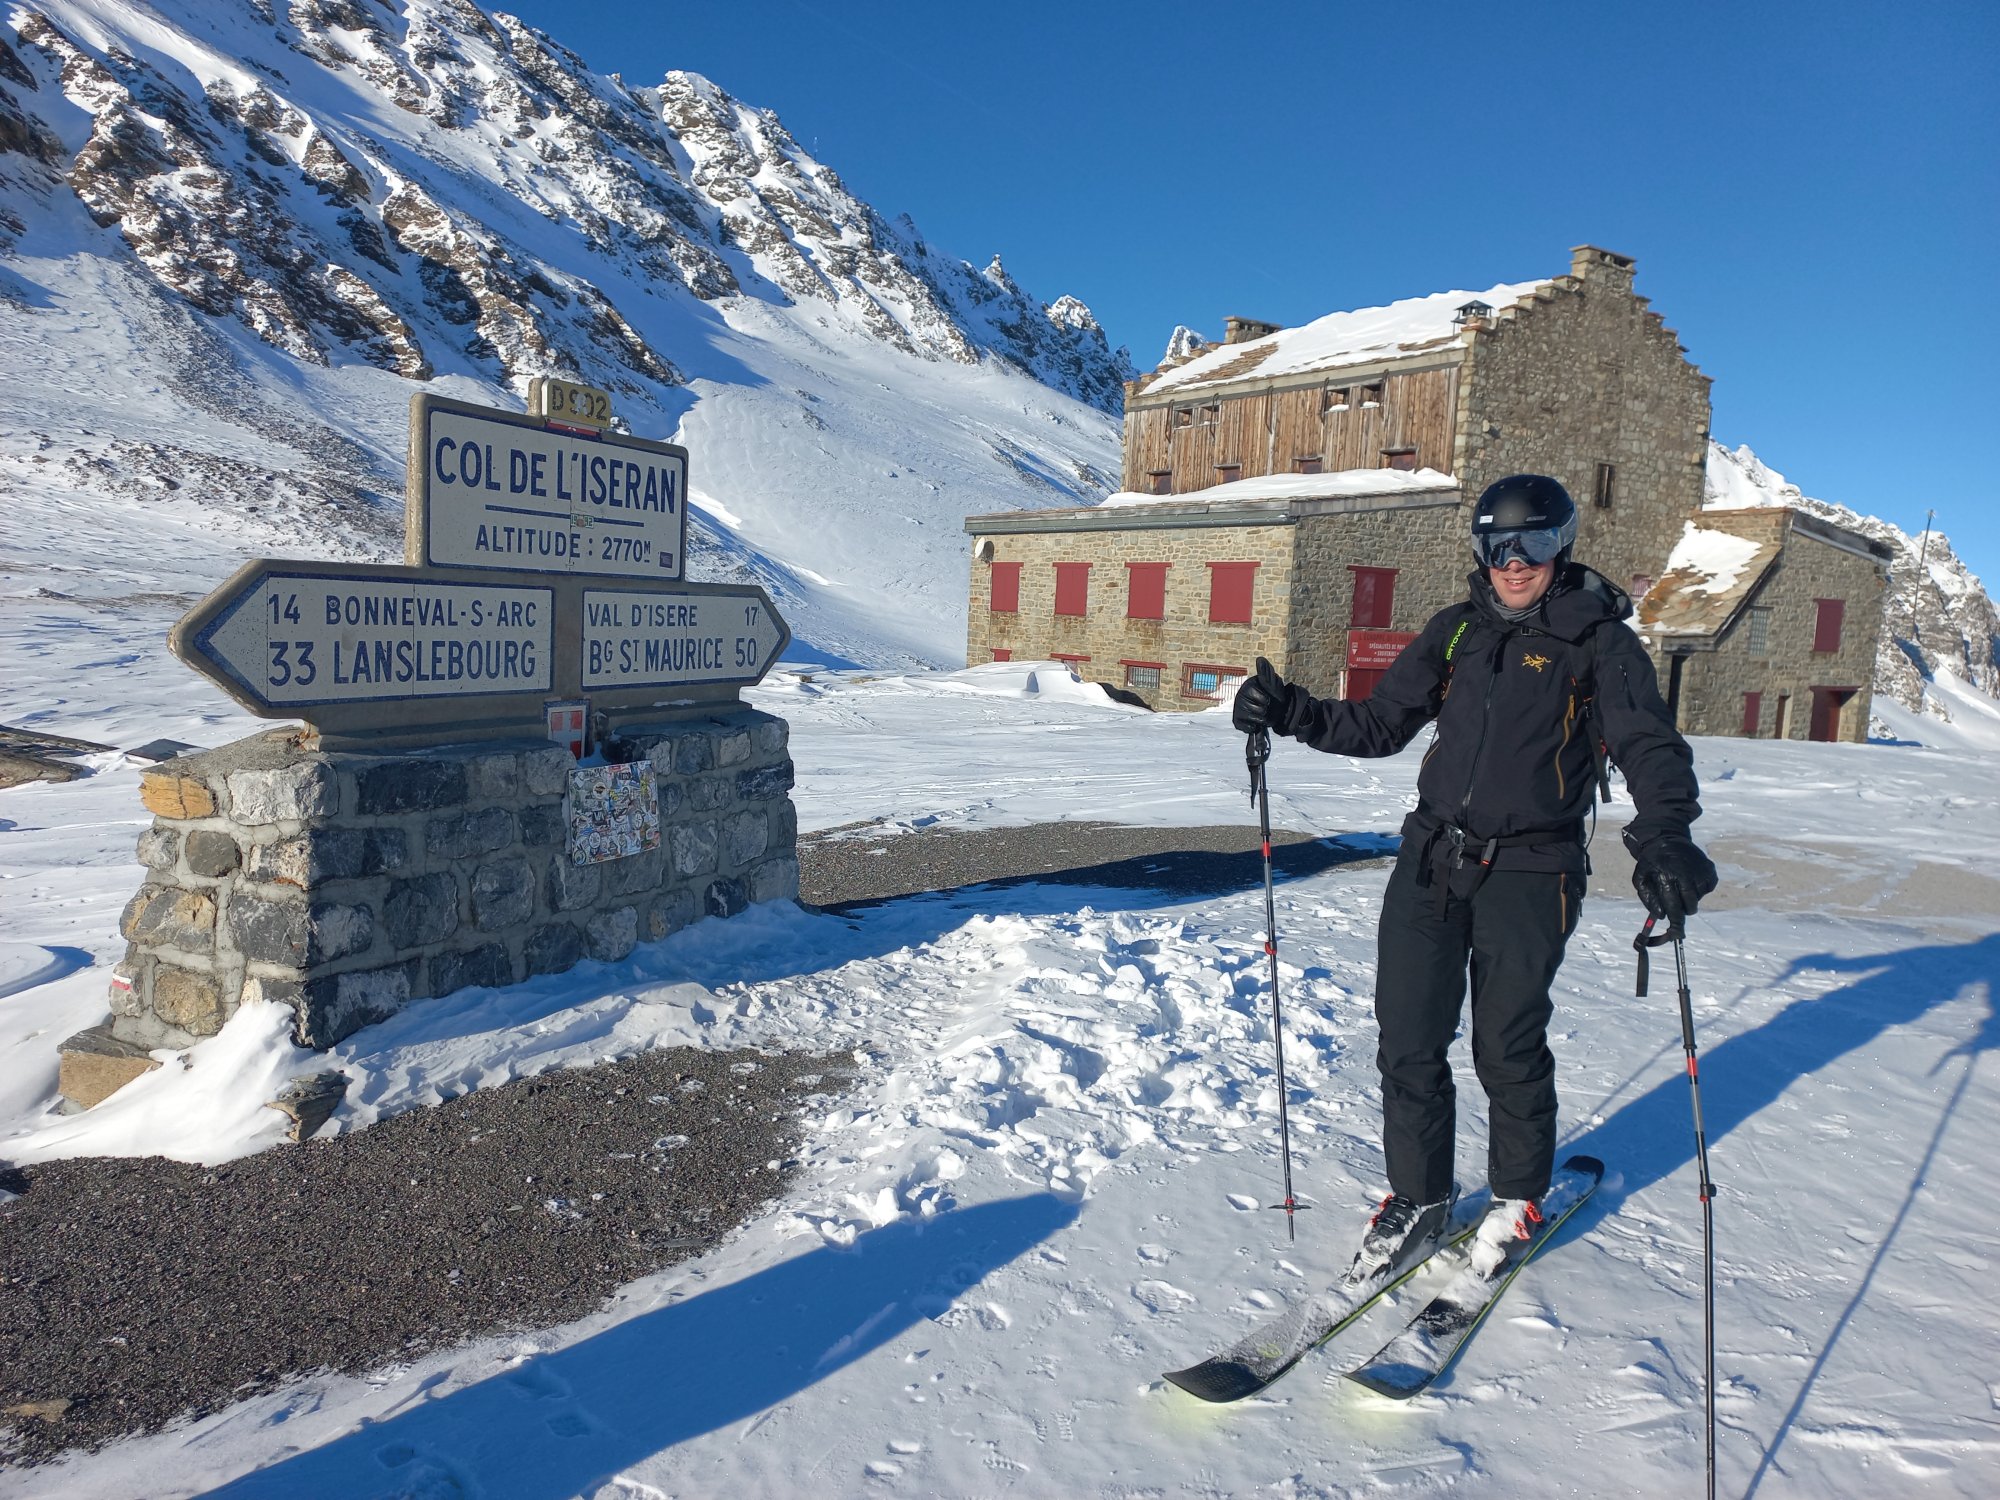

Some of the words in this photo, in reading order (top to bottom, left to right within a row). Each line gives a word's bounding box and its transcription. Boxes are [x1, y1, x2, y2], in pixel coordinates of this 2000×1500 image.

[552, 384, 564, 411] D
[435, 437, 501, 491] COL
[509, 449, 547, 497] DE
[557, 449, 676, 514] L'ISERAN
[475, 524, 581, 559] ALTITUDE
[268, 593, 300, 625] 14
[588, 603, 622, 627] VAL
[632, 604, 698, 627] D'ISERE
[745, 606, 758, 626] 17
[645, 637, 723, 672] MAURICE
[735, 637, 757, 668] 50
[1446, 621, 1469, 660] ORTOVOX
[268, 641, 316, 687] 33
[334, 640, 536, 685] LANSLEBOURG
